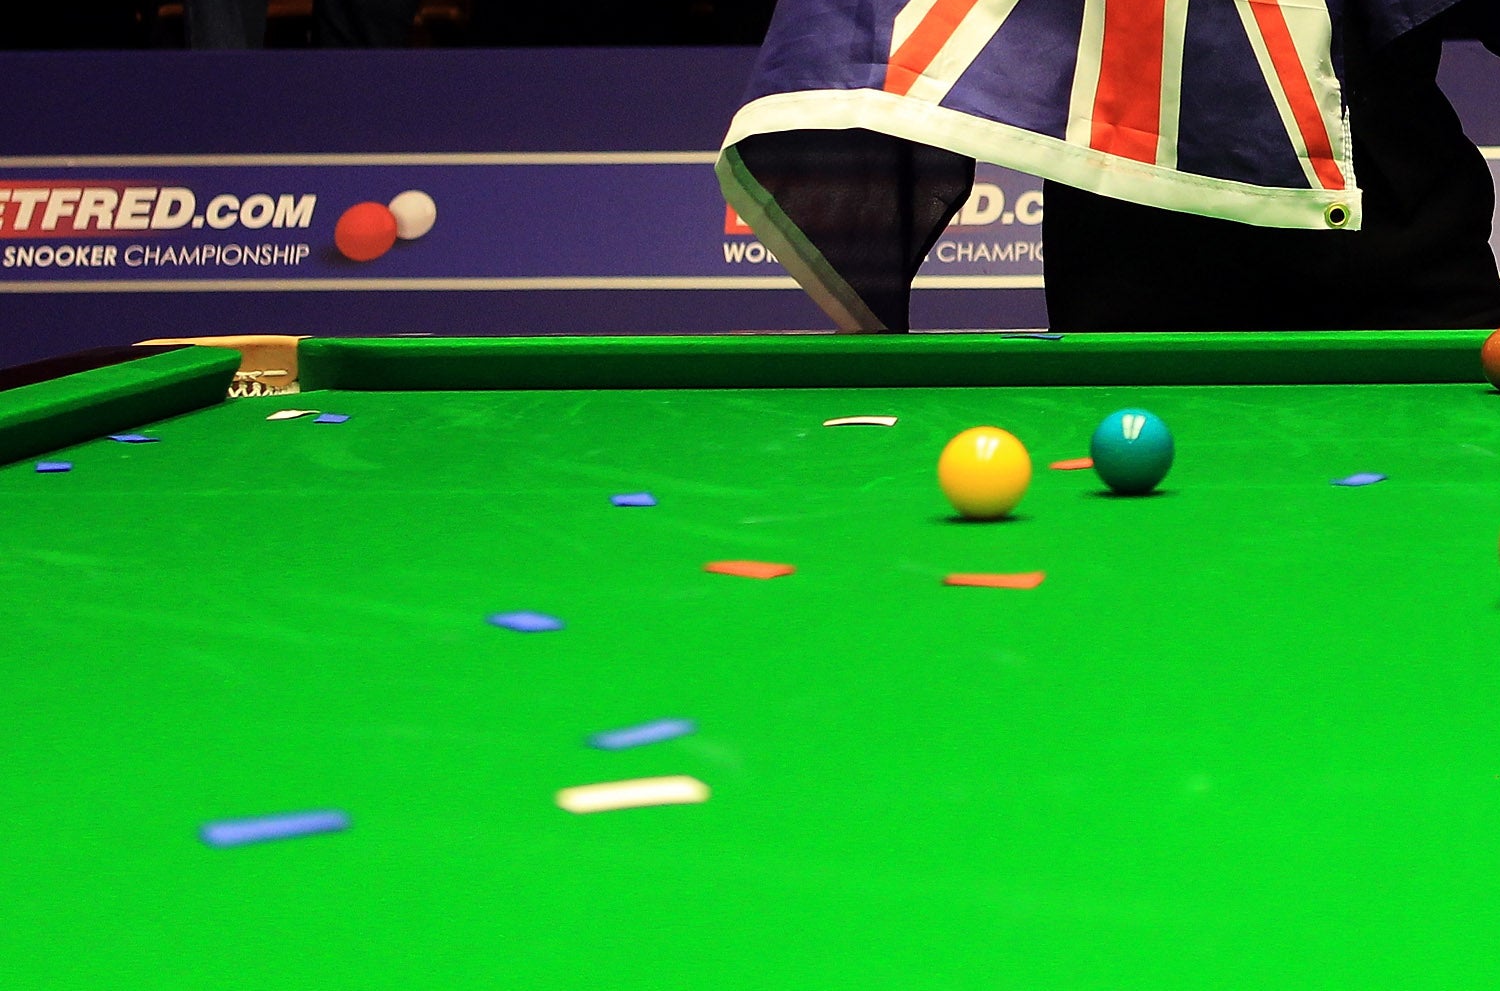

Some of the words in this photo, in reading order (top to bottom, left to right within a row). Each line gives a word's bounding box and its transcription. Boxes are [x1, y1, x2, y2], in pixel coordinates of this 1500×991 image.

[0, 186, 317, 231] TFRED.COM
[3, 245, 118, 267] SNOOKER
[124, 243, 310, 267] CHAMPIONSHIP
